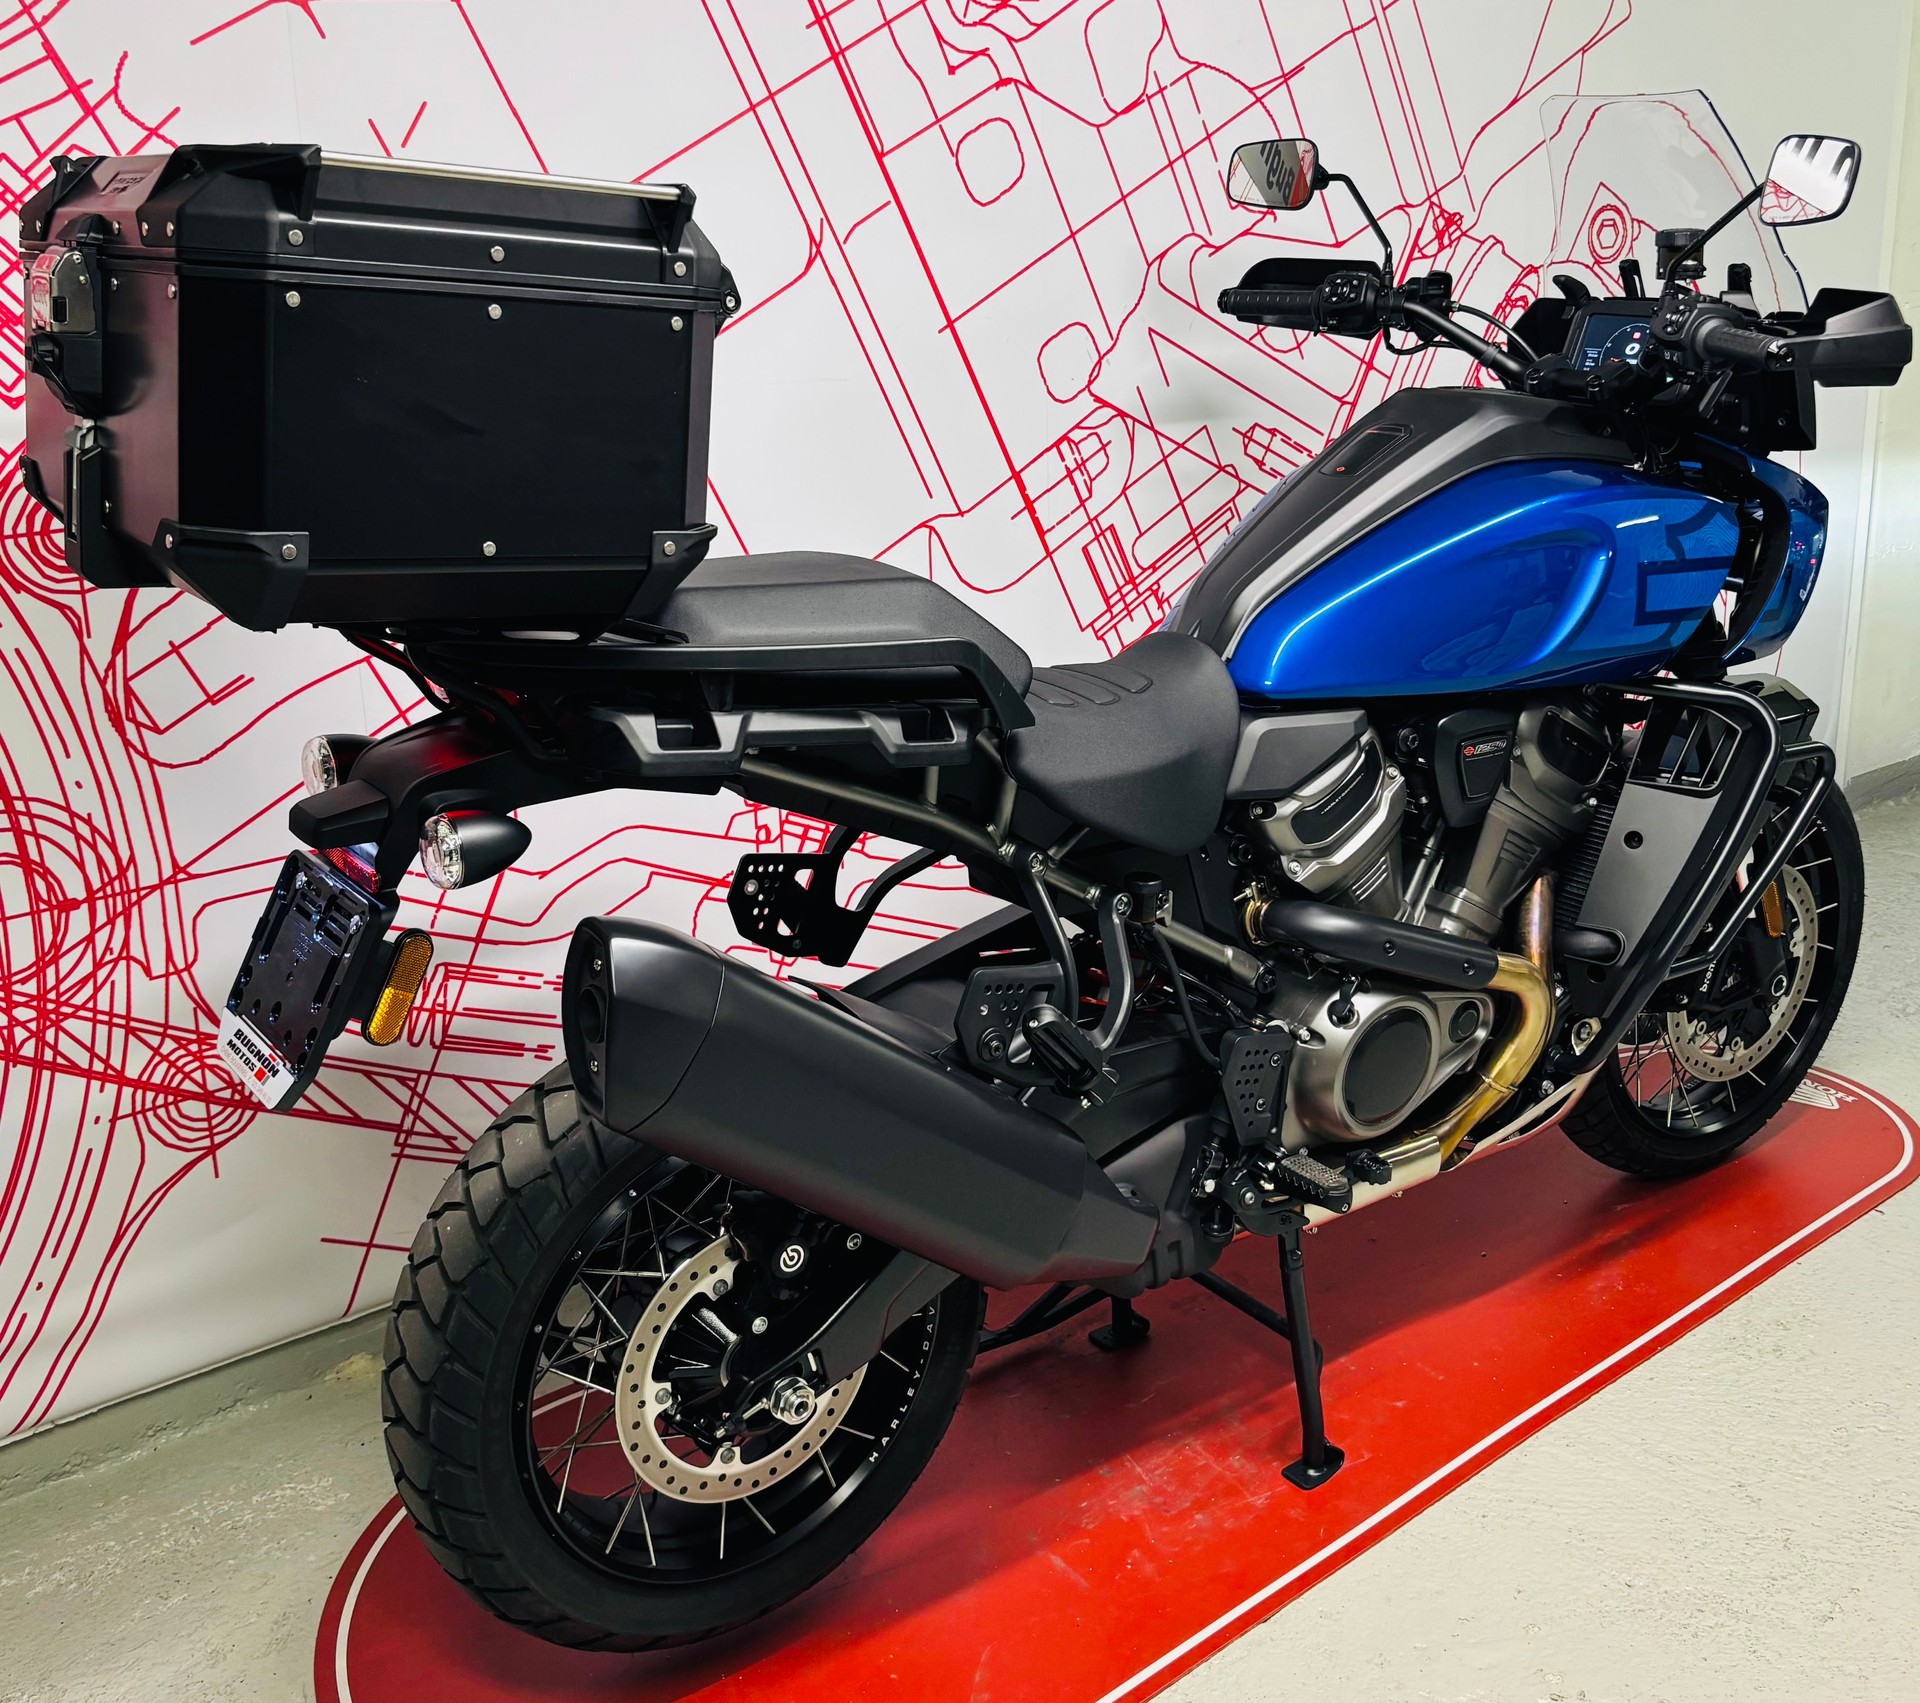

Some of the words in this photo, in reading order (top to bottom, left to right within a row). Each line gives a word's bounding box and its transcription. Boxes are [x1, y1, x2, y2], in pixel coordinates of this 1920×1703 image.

[226, 1038, 257, 1072] MOTOS
[233, 1028, 280, 1078] BUGNON
[868, 1306, 936, 1463] HARLEY-DAV
